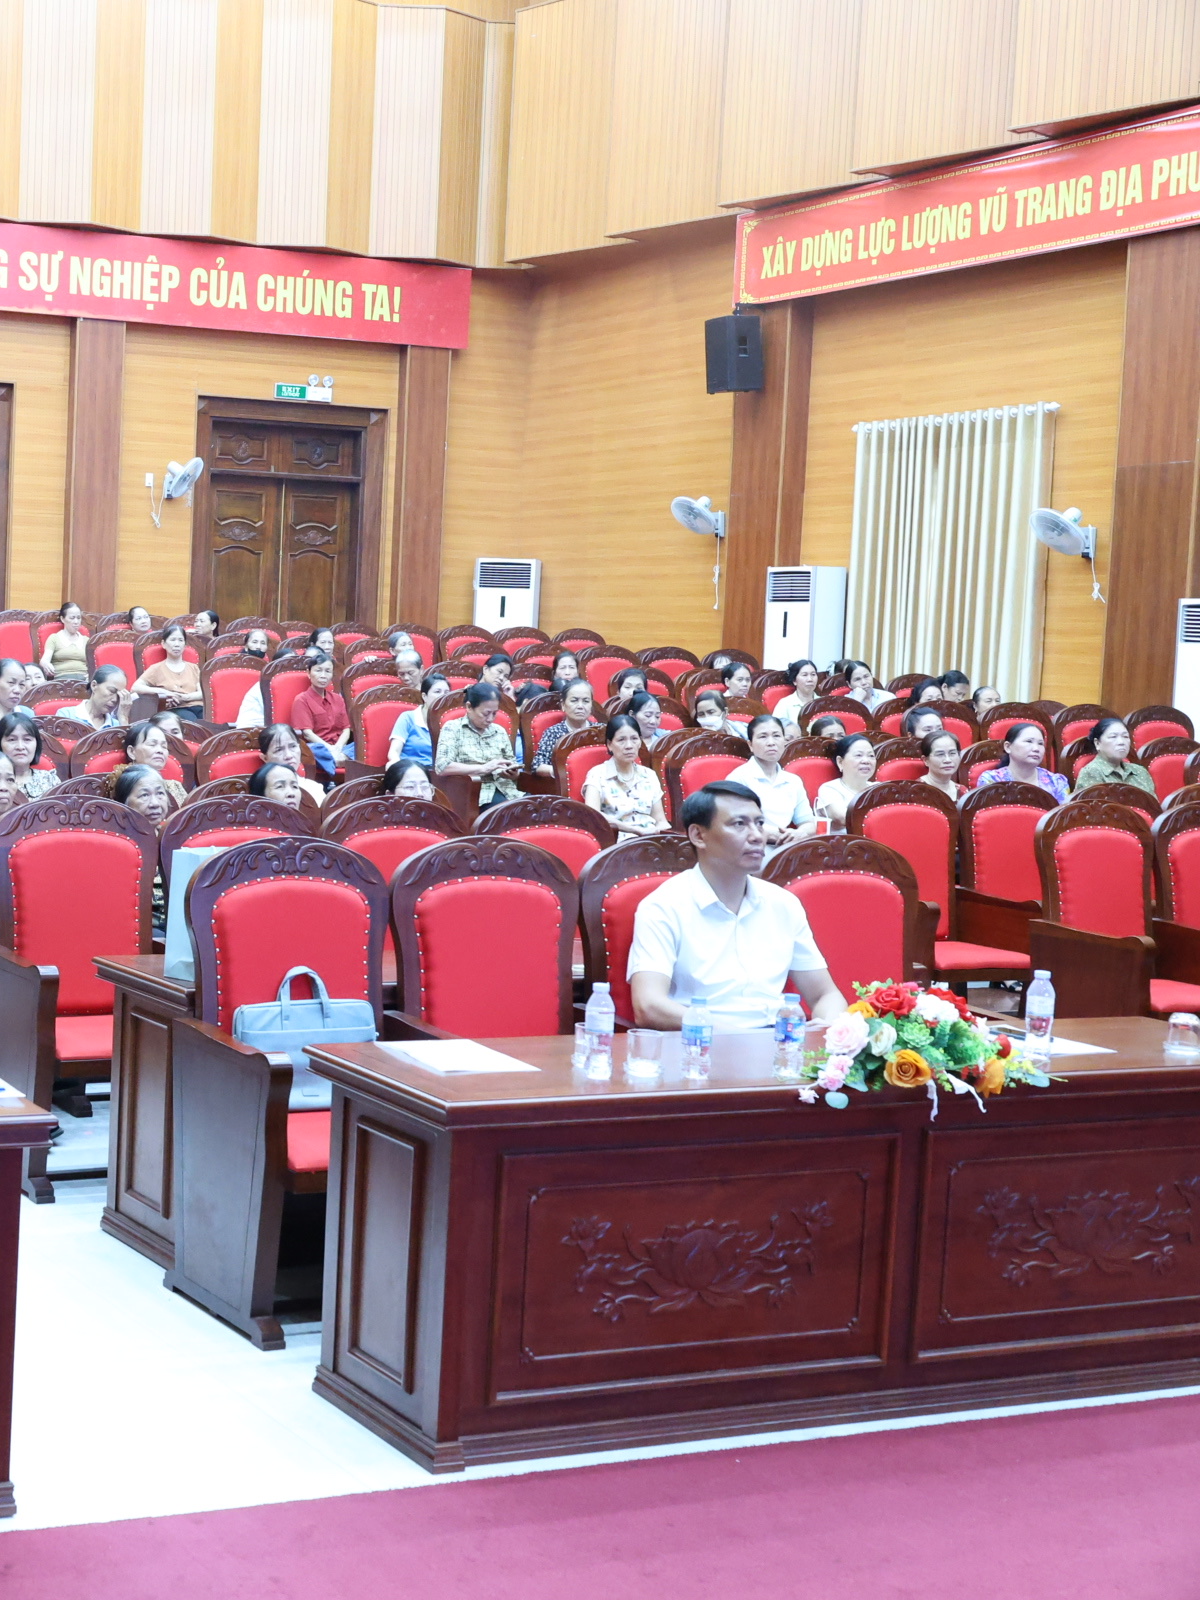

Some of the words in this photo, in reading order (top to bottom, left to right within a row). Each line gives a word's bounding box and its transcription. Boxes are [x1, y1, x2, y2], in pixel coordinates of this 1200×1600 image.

[761, 236, 797, 279] XÂY
[801, 228, 853, 276] DỰNG
[858, 216, 896, 266] LỰC
[901, 202, 972, 254] LƯỢNG
[979, 186, 1007, 236] VŨ
[1015, 175, 1092, 227] TRANG
[1100, 163, 1143, 217] ĐỊA
[18, 249, 64, 301] SỰ
[69, 255, 180, 310] NGHIỆP
[190, 257, 247, 309] CỦA
[257, 270, 352, 318] CHÚNG
[362, 284, 401, 323] TA!
